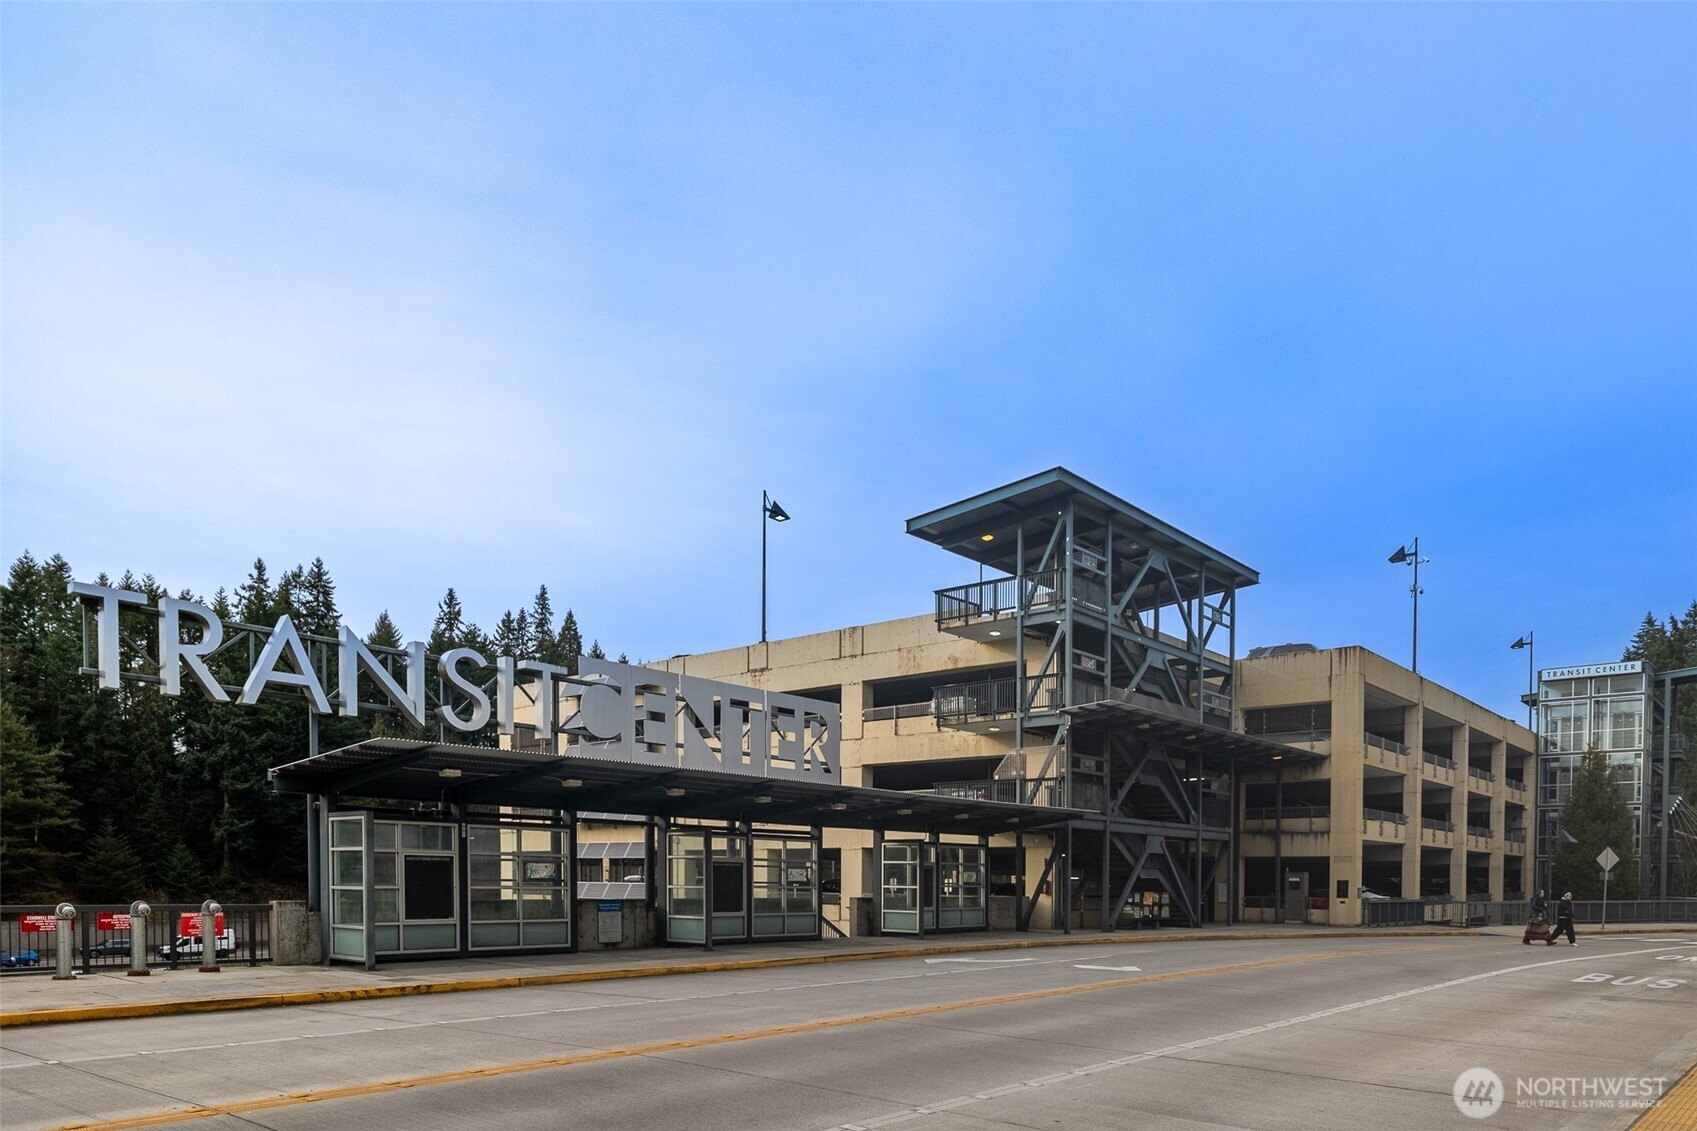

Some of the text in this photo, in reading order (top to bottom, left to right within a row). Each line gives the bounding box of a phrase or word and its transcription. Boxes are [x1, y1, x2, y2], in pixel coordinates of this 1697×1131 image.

[67, 581, 834, 777] TRANSIT CENTER
[1546, 663, 1636, 678] TRANSIT CENTER
[1570, 972, 1688, 989] BUS
